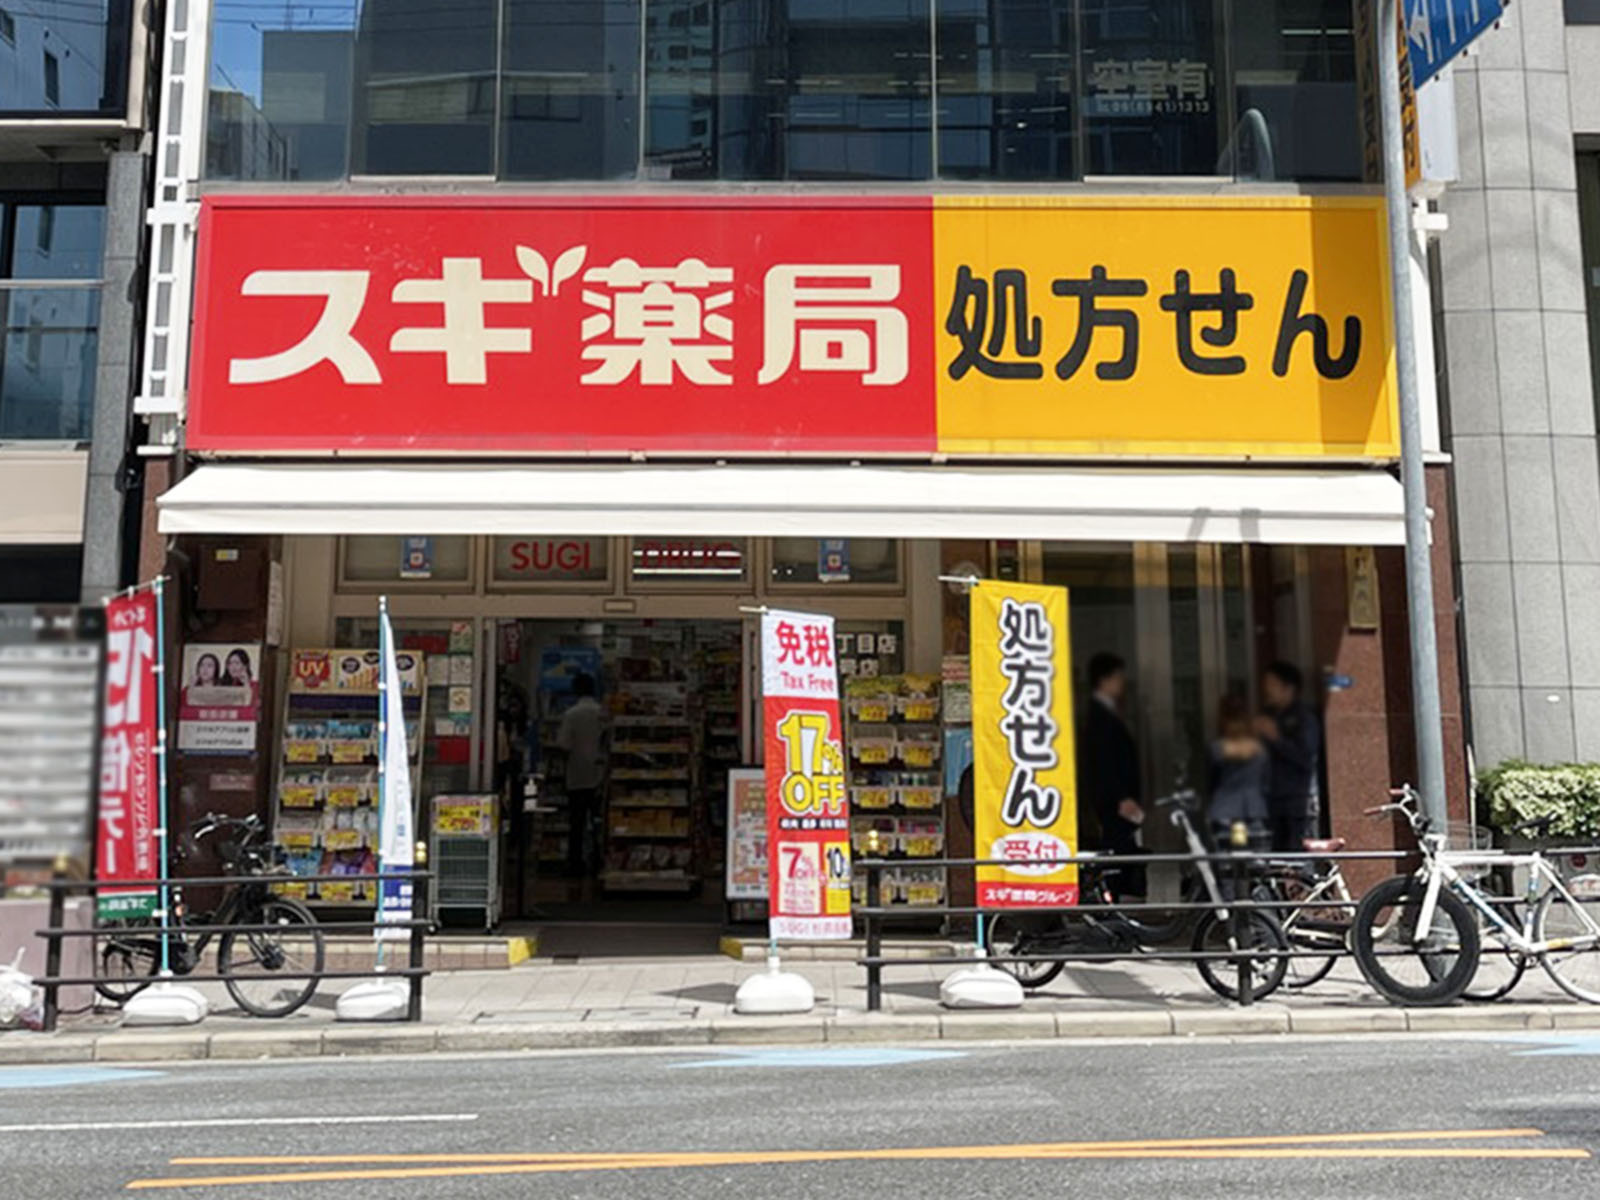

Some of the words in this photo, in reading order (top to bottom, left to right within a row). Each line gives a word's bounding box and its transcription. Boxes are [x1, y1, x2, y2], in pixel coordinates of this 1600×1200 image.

[1093, 58, 1208, 100] 空室有
[228, 244, 909, 386] スギ薬局
[945, 264, 1362, 381] 処方せん
[510, 541, 590, 571] SUGI
[775, 620, 833, 667] 免税
[299, 661, 325, 675] UV
[780, 671, 805, 690] Tax
[808, 674, 835, 692] Free
[1000, 597, 1060, 828] 処方せん
[780, 773, 846, 815] OFF
[1003, 838, 1059, 870] 受付
